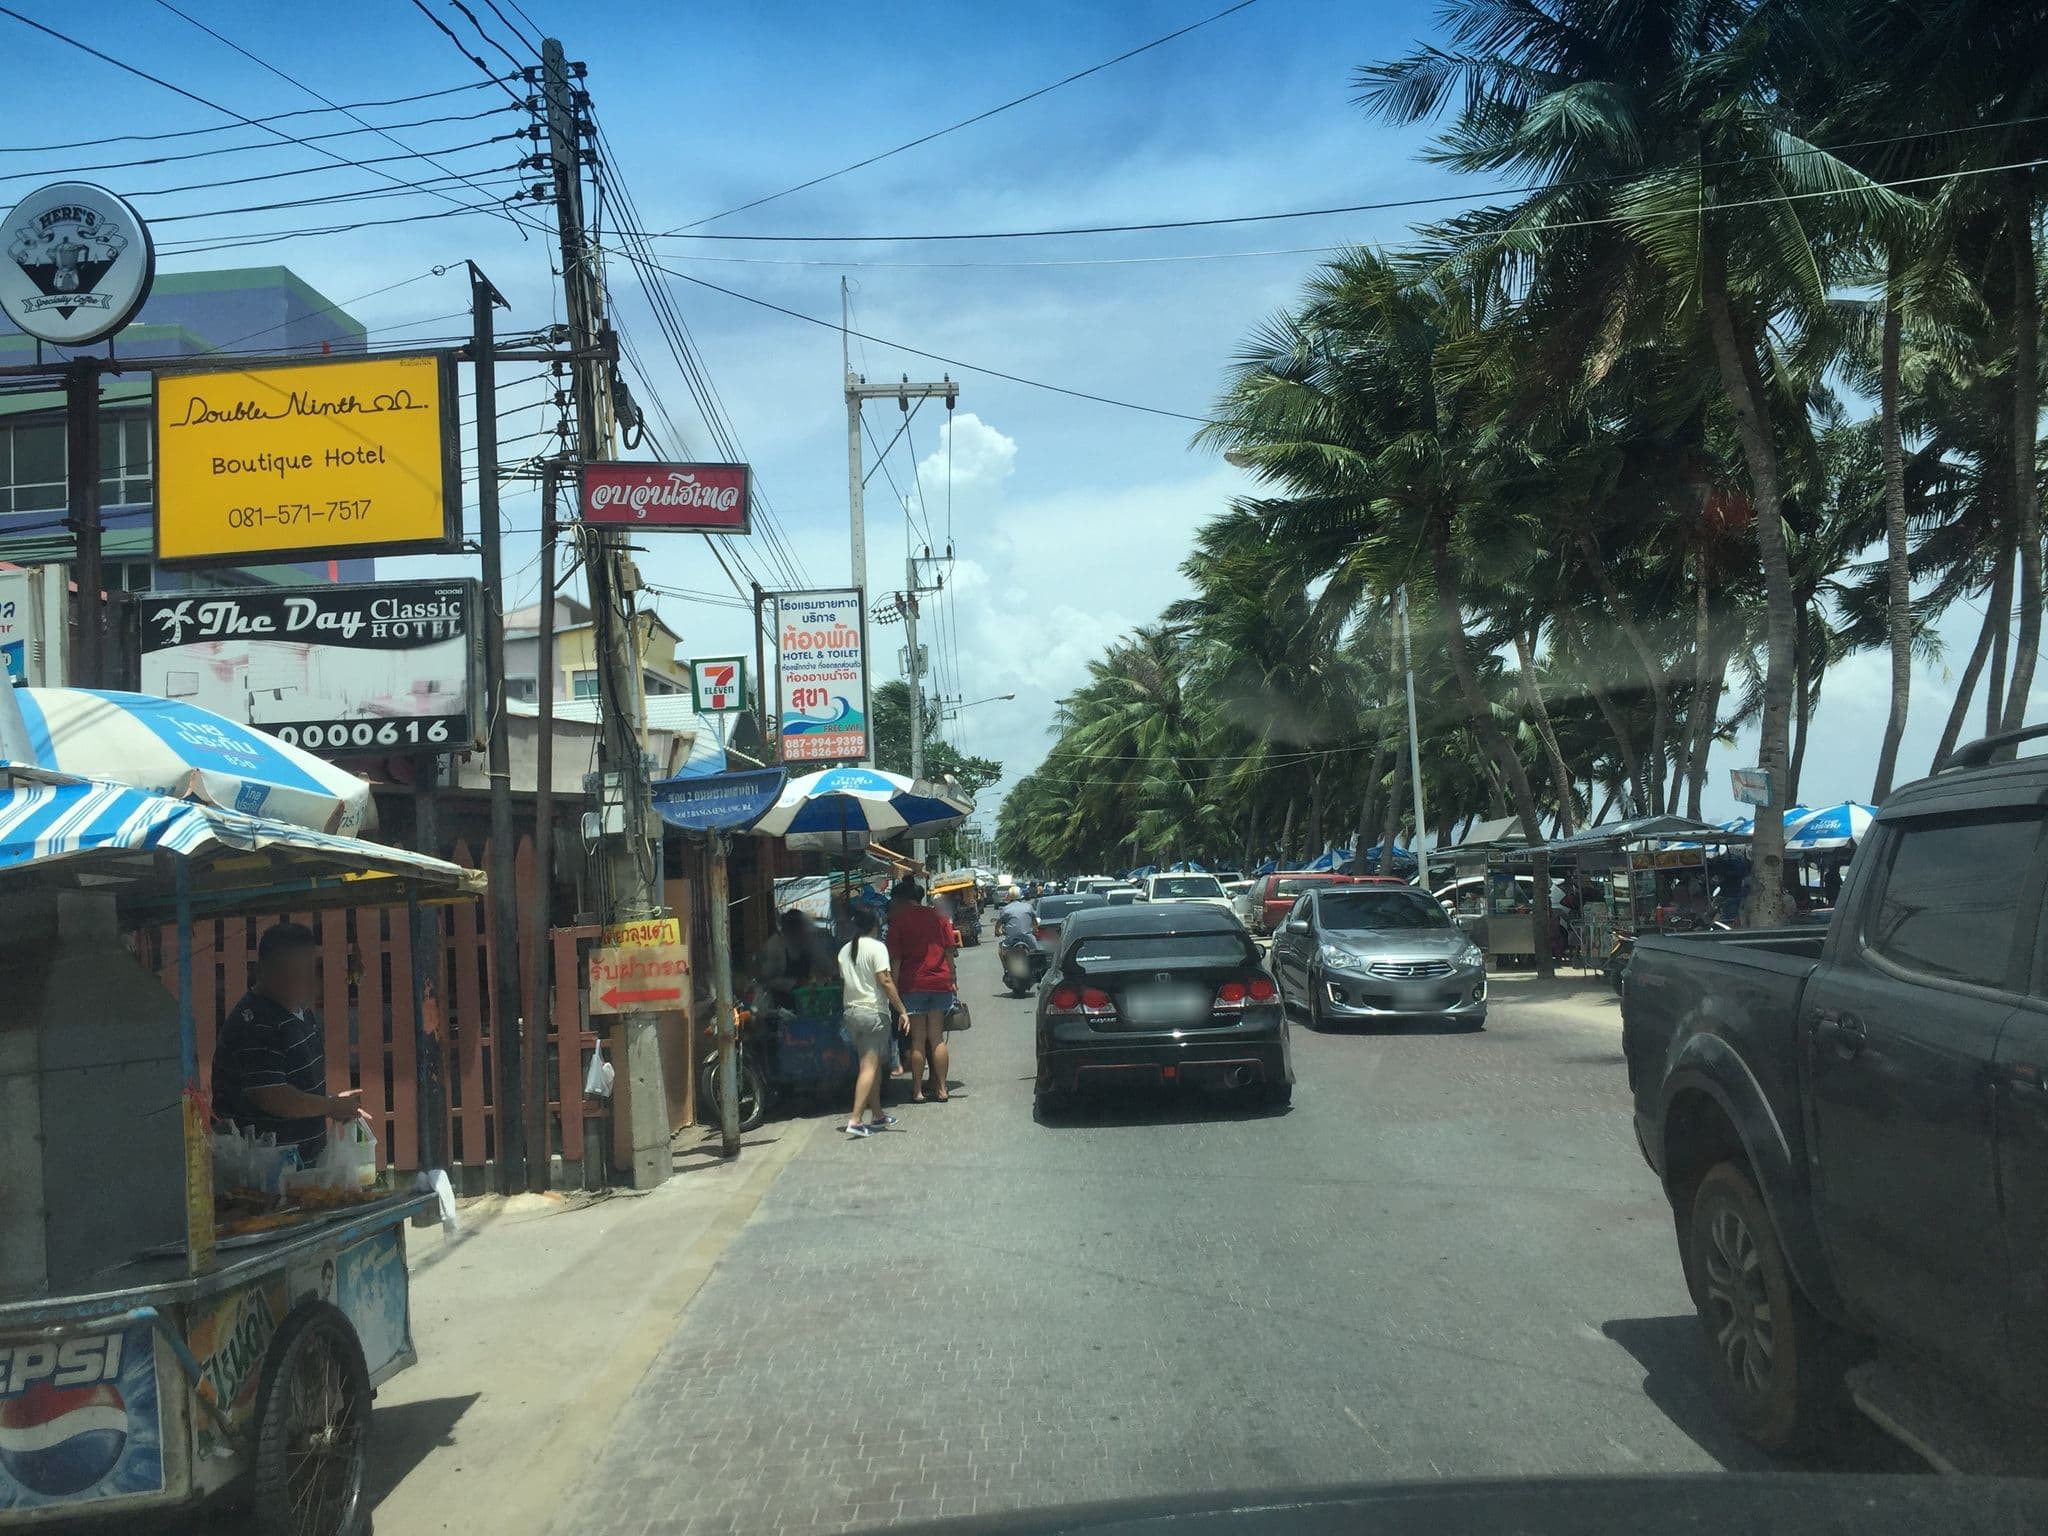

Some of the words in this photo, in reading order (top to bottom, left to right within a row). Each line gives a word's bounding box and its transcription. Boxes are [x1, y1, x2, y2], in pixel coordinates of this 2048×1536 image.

[39, 206, 96, 230] HERE'S
[170, 396, 272, 427] Double
[282, 391, 364, 416] Ninth
[212, 453, 313, 479] Boutique
[325, 445, 386, 468] Hotel
[590, 472, 740, 519] อบอุ่นโฮเทล
[228, 499, 372, 529] 081-571-7517
[198, 600, 277, 635] The
[283, 597, 367, 639] Day
[370, 596, 461, 620] Classic
[370, 620, 461, 638] HOTEL
[802, 611, 837, 623] บริการ
[783, 623, 859, 651] ห้องพัก
[783, 651, 814, 661] HOTEL
[816, 650, 824, 659] &
[827, 649, 859, 659] TOILET
[704, 665, 734, 708] 7
[792, 687, 829, 715] สุขา
[784, 736, 865, 749] 087-994-9398
[785, 746, 865, 759] 081-826-9697
[687, 791, 693, 802] 2
[0, 1333, 124, 1394] PSI
